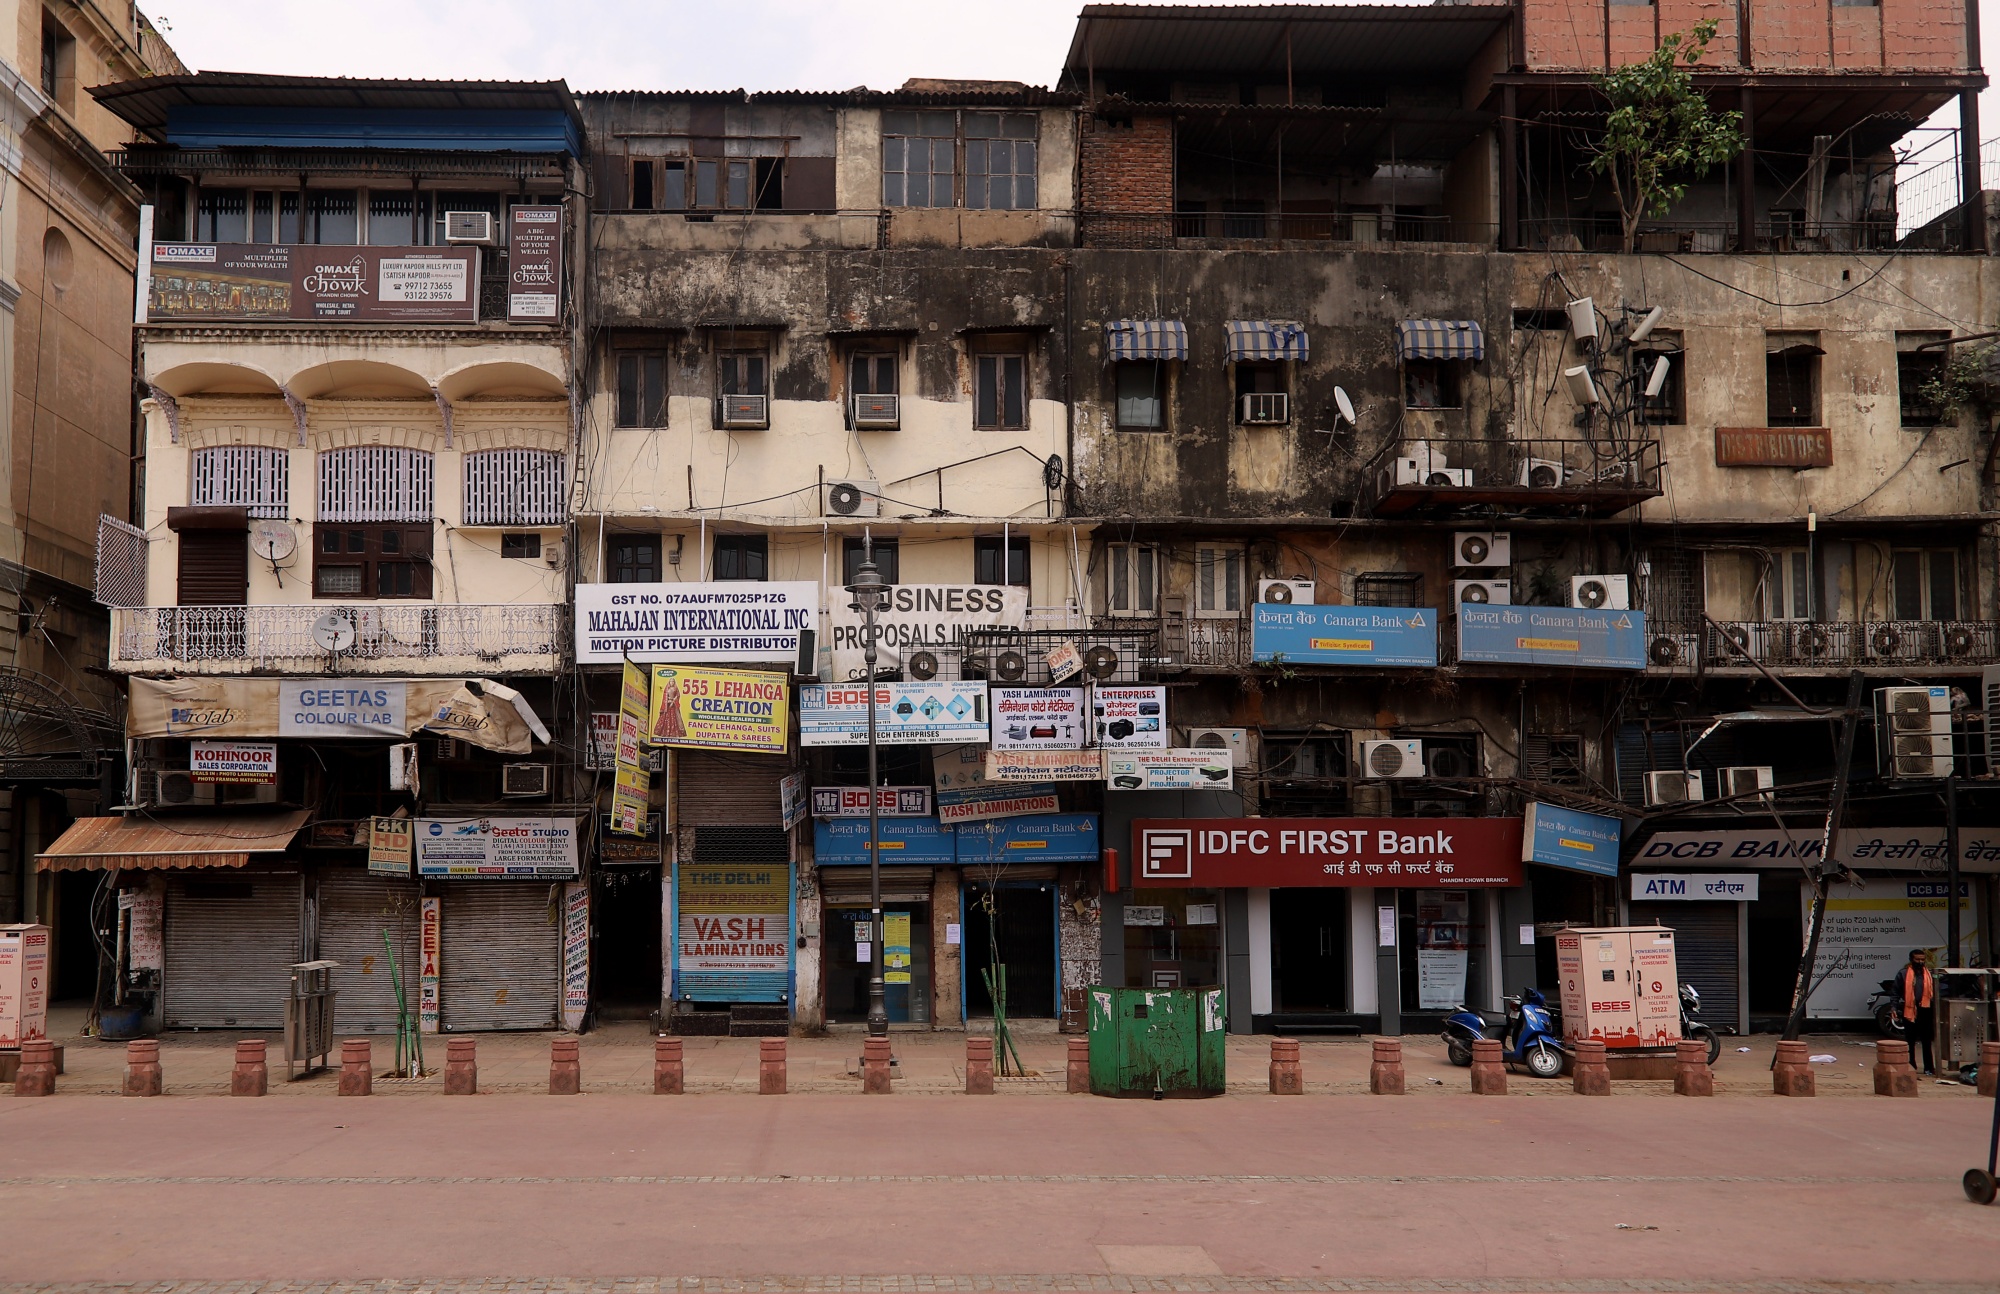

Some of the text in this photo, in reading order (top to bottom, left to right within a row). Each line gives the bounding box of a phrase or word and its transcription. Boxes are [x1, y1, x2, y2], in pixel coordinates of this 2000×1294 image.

[168, 247, 214, 256] OMAXE
[314, 265, 360, 274] OMAXE
[513, 269, 555, 284] Chowk
[303, 273, 369, 295] Chowk
[404, 281, 453, 290] 99712 73655
[404, 291, 453, 300] 93122 39576
[611, 593, 787, 605] GST NO. 07AAUFM7025P1ZG
[588, 608, 810, 632] MAHAJAN INTERNATIONAL INC
[1258, 610, 1403, 628] केनरा बैंक Canara Bank
[1464, 609, 1610, 629] केनरा बैंक Canara Bank
[590, 638, 645, 651] MOTION
[649, 637, 706, 650] PICTURE
[682, 678, 784, 701] 555 LEHANGA
[1002, 690, 1072, 698] YASH LAMINATION
[1101, 690, 1156, 699] ENTERPRISES
[299, 689, 389, 707] GEETAS
[690, 697, 773, 716] CREATION
[998, 699, 1046, 713] लेमिनेशन फोटो
[1106, 701, 1138, 710] प्रोजेक्टर
[294, 712, 393, 725] COLOUR LAB
[1106, 709, 1138, 718] प्रोजेक्टर
[687, 721, 781, 733] FANCY LEHANGA, SUITS
[695, 731, 772, 742] DUPATTA SAREES
[849, 730, 940, 740] SUPEECH ENTERPRISES
[194, 750, 273, 763] KOHINOOR
[995, 753, 1102, 766] YASH LAMINATIONS
[198, 762, 268, 771] SALES CORPORATION
[997, 764, 1101, 775] लेमिनेशन मटेरियल
[943, 797, 1056, 818] YASH LAMINATIONS
[377, 819, 405, 833] 4K
[829, 823, 938, 834] केनरा Canara Bank
[1016, 823, 1076, 834] Canara Bank
[532, 829, 570, 837] STUDIO
[1568, 825, 1608, 840] Canara Bank
[374, 833, 408, 848] HD
[1198, 829, 1455, 855] IDFC FIRST Bank
[1642, 839, 1825, 858] DCB BANK
[370, 852, 409, 862] VIDEO EDITING
[1322, 859, 1455, 876] आई डी एफ सी फर्स्ट बैंक
[689, 873, 771, 885] THE DELHI
[1645, 879, 1686, 895] ATM
[1704, 879, 1745, 895] एटीएम
[1910, 885, 1933, 895] DCB
[679, 892, 778, 905] ENTERPRISES
[1928, 900, 1946, 908] Gold
[567, 907, 588, 922] PHOTO
[1835, 916, 1901, 926] upto lakh with
[693, 917, 765, 941] YASH
[1880, 926, 1906, 934] against
[26, 934, 47, 944] BSES
[423, 909, 436, 976] GEETA
[566, 931, 587, 946] COLOR
[1558, 938, 1579, 947] BSES
[1825, 935, 1875, 944] gold jewellery
[683, 943, 785, 957] LAMINATIONS
[566, 990, 588, 999] GEETA
[565, 998, 588, 1007] STUDIO
[1591, 1000, 1631, 1010] BSES
